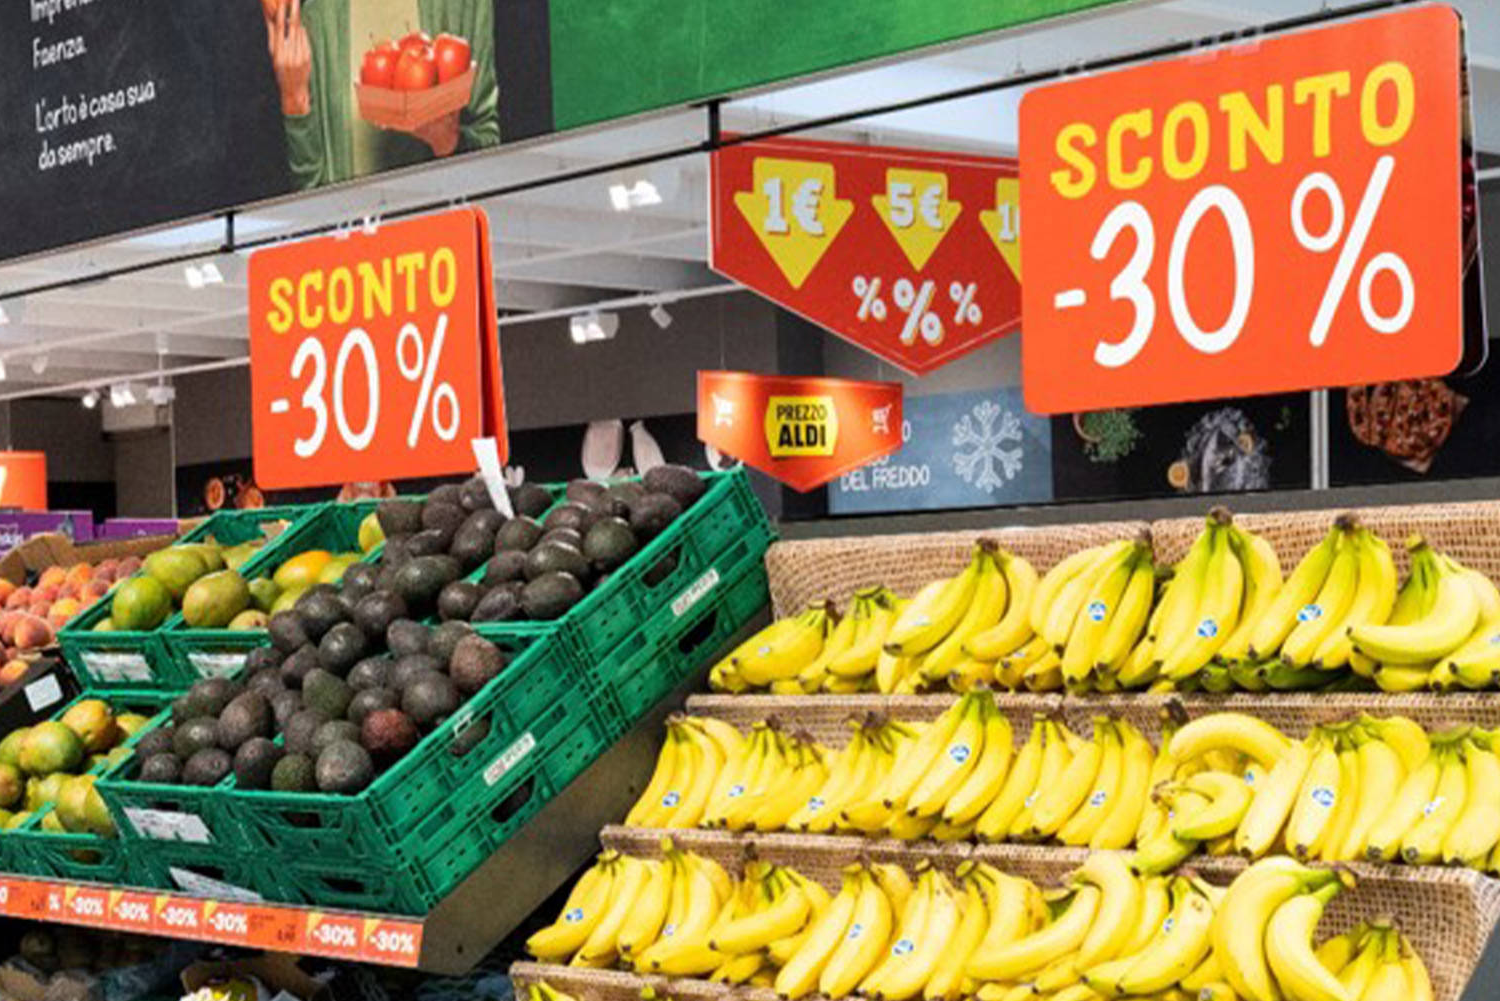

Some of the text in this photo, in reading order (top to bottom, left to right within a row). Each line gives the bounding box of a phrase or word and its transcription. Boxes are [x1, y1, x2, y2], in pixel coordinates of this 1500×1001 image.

[32, 35, 87, 69] Faenza.
[89, 90, 125, 118] casa
[126, 80, 156, 106] sua
[1050, 61, 1414, 199] SCONTO
[38, 131, 117, 170] da sempre.
[1055, 156, 1414, 367] -30 %
[267, 247, 456, 333] SCONTO
[272, 314, 460, 456] -30 %
[776, 404, 828, 420] PREZZO
[779, 424, 826, 447] ALDI
[872, 464, 931, 489] FREDDO
[160, 906, 198, 927] -30%
[208, 912, 248, 934] -30%
[313, 923, 356, 947] -30%
[370, 930, 414, 954] -30%
